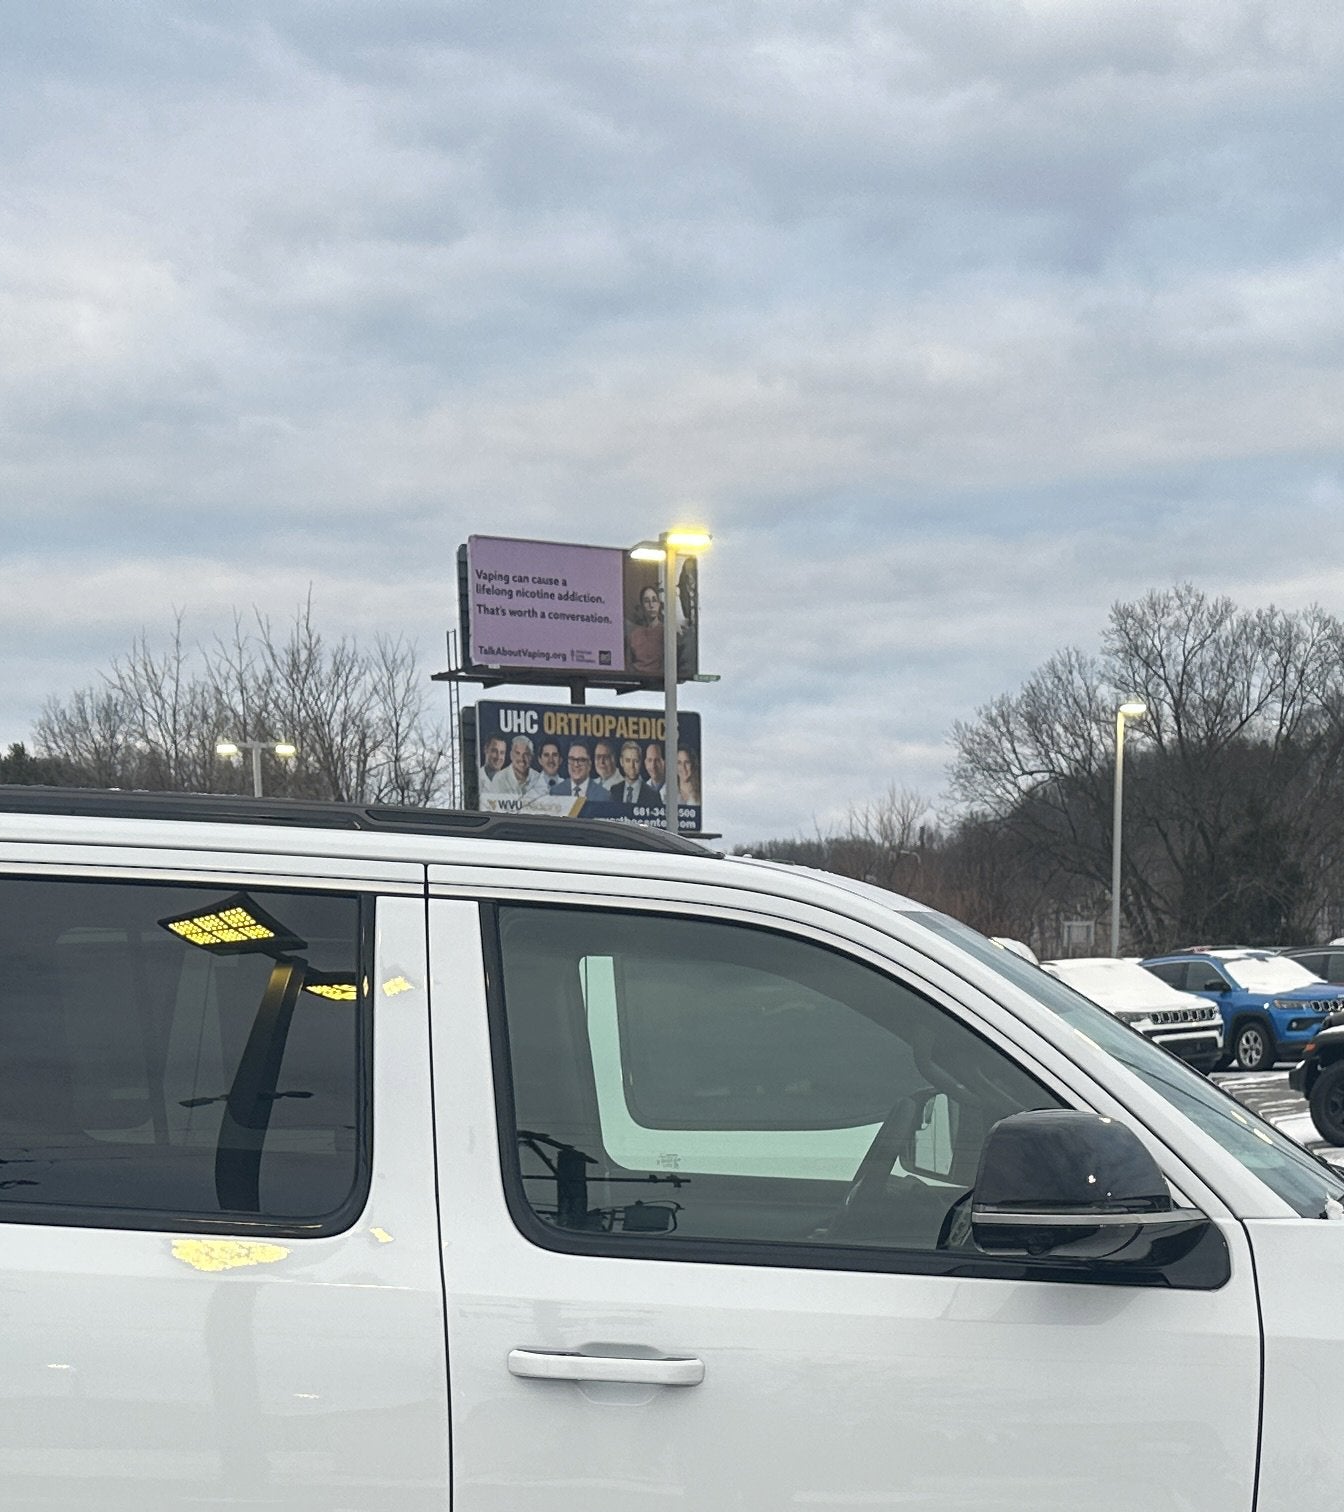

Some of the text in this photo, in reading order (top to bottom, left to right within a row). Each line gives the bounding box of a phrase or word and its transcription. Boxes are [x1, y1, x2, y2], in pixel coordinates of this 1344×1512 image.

[475, 569, 567, 587] Vaping can cause a
[476, 584, 605, 604] lifelong nicotine addiction.
[476, 604, 507, 617] That's
[509, 608, 538, 619] worth
[548, 611, 612, 624] conversation.
[478, 646, 567, 661] TalkAboutVaping.org
[499, 709, 679, 741] UHC ORTHOPAEDIC
[497, 799, 523, 811] WVU
